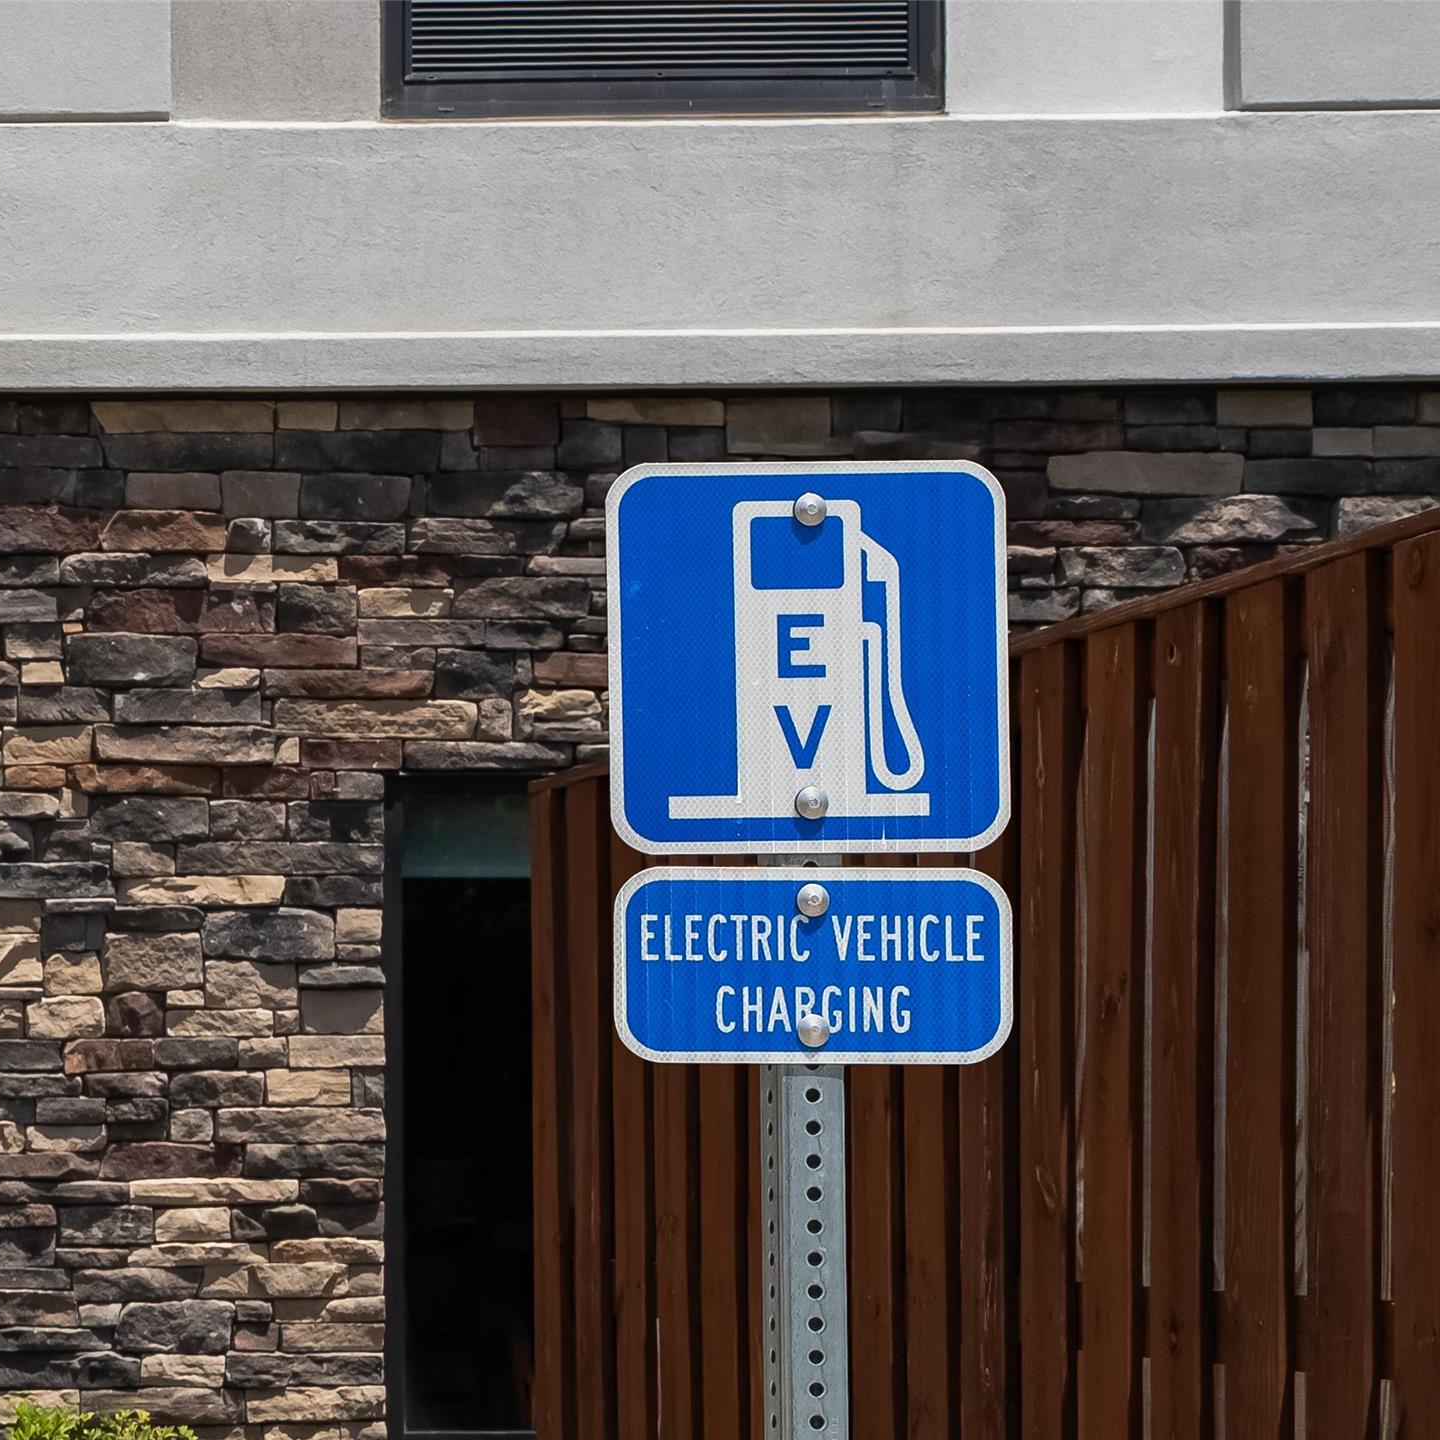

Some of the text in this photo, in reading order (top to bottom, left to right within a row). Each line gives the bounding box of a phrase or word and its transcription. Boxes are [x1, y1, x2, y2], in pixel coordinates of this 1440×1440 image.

[641, 914, 985, 962] ELECTRIC VEHICLE
[716, 985, 912, 1034] CHARGING
